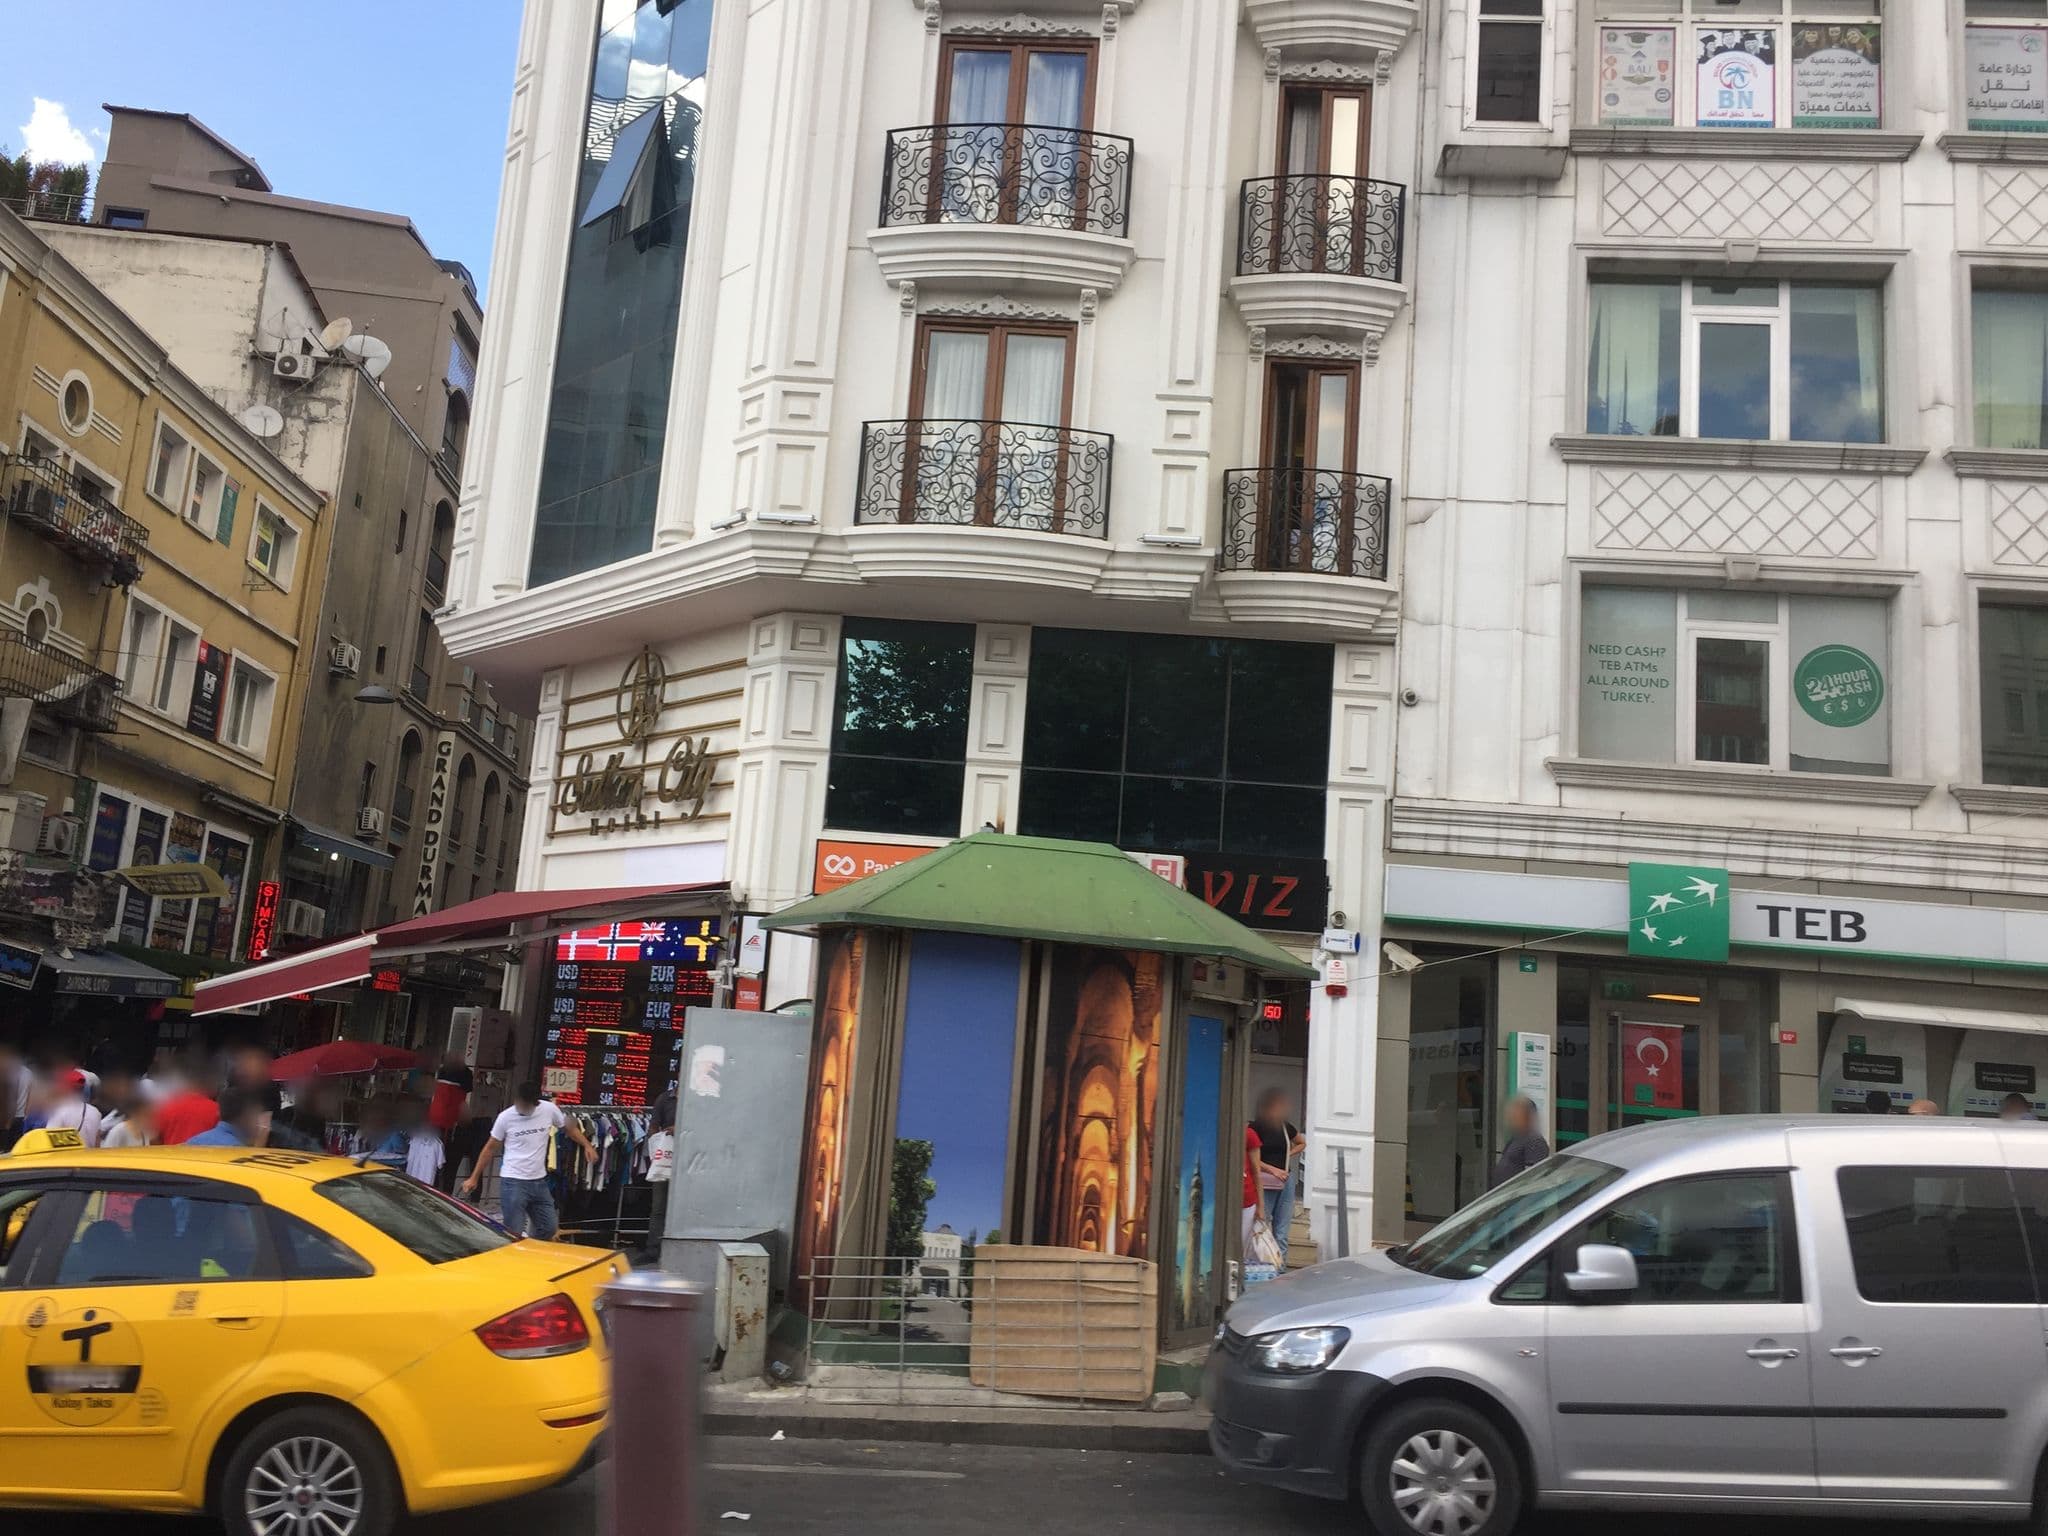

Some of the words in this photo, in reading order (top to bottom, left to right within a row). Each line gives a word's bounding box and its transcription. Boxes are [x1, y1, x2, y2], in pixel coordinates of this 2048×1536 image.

[1978, 63, 2004, 73] عامة
[1718, 90, 1752, 109] BN
[1800, 101, 1831, 114] مميزة
[1834, 101, 1872, 112] خدمات
[1588, 644, 1622, 655] NEED
[1625, 645, 1666, 657] CASH?
[1599, 659, 1621, 671] TEB
[1624, 661, 1658, 672] ATMs
[1587, 675, 1608, 686] ALL
[1612, 676, 1670, 689] AROUND
[1833, 668, 1869, 685] HOUR
[1838, 680, 1873, 697] CASH
[1601, 690, 1655, 704] TURKEY.
[427, 740, 453, 825] GRAND
[658, 736, 720, 822] City
[252, 886, 275, 960] SIMCARD
[1756, 904, 1867, 943] TEB
[557, 964, 579, 980] USD
[650, 965, 675, 982] EUR
[553, 997, 575, 1013] USD
[645, 1001, 671, 1018] EUR
